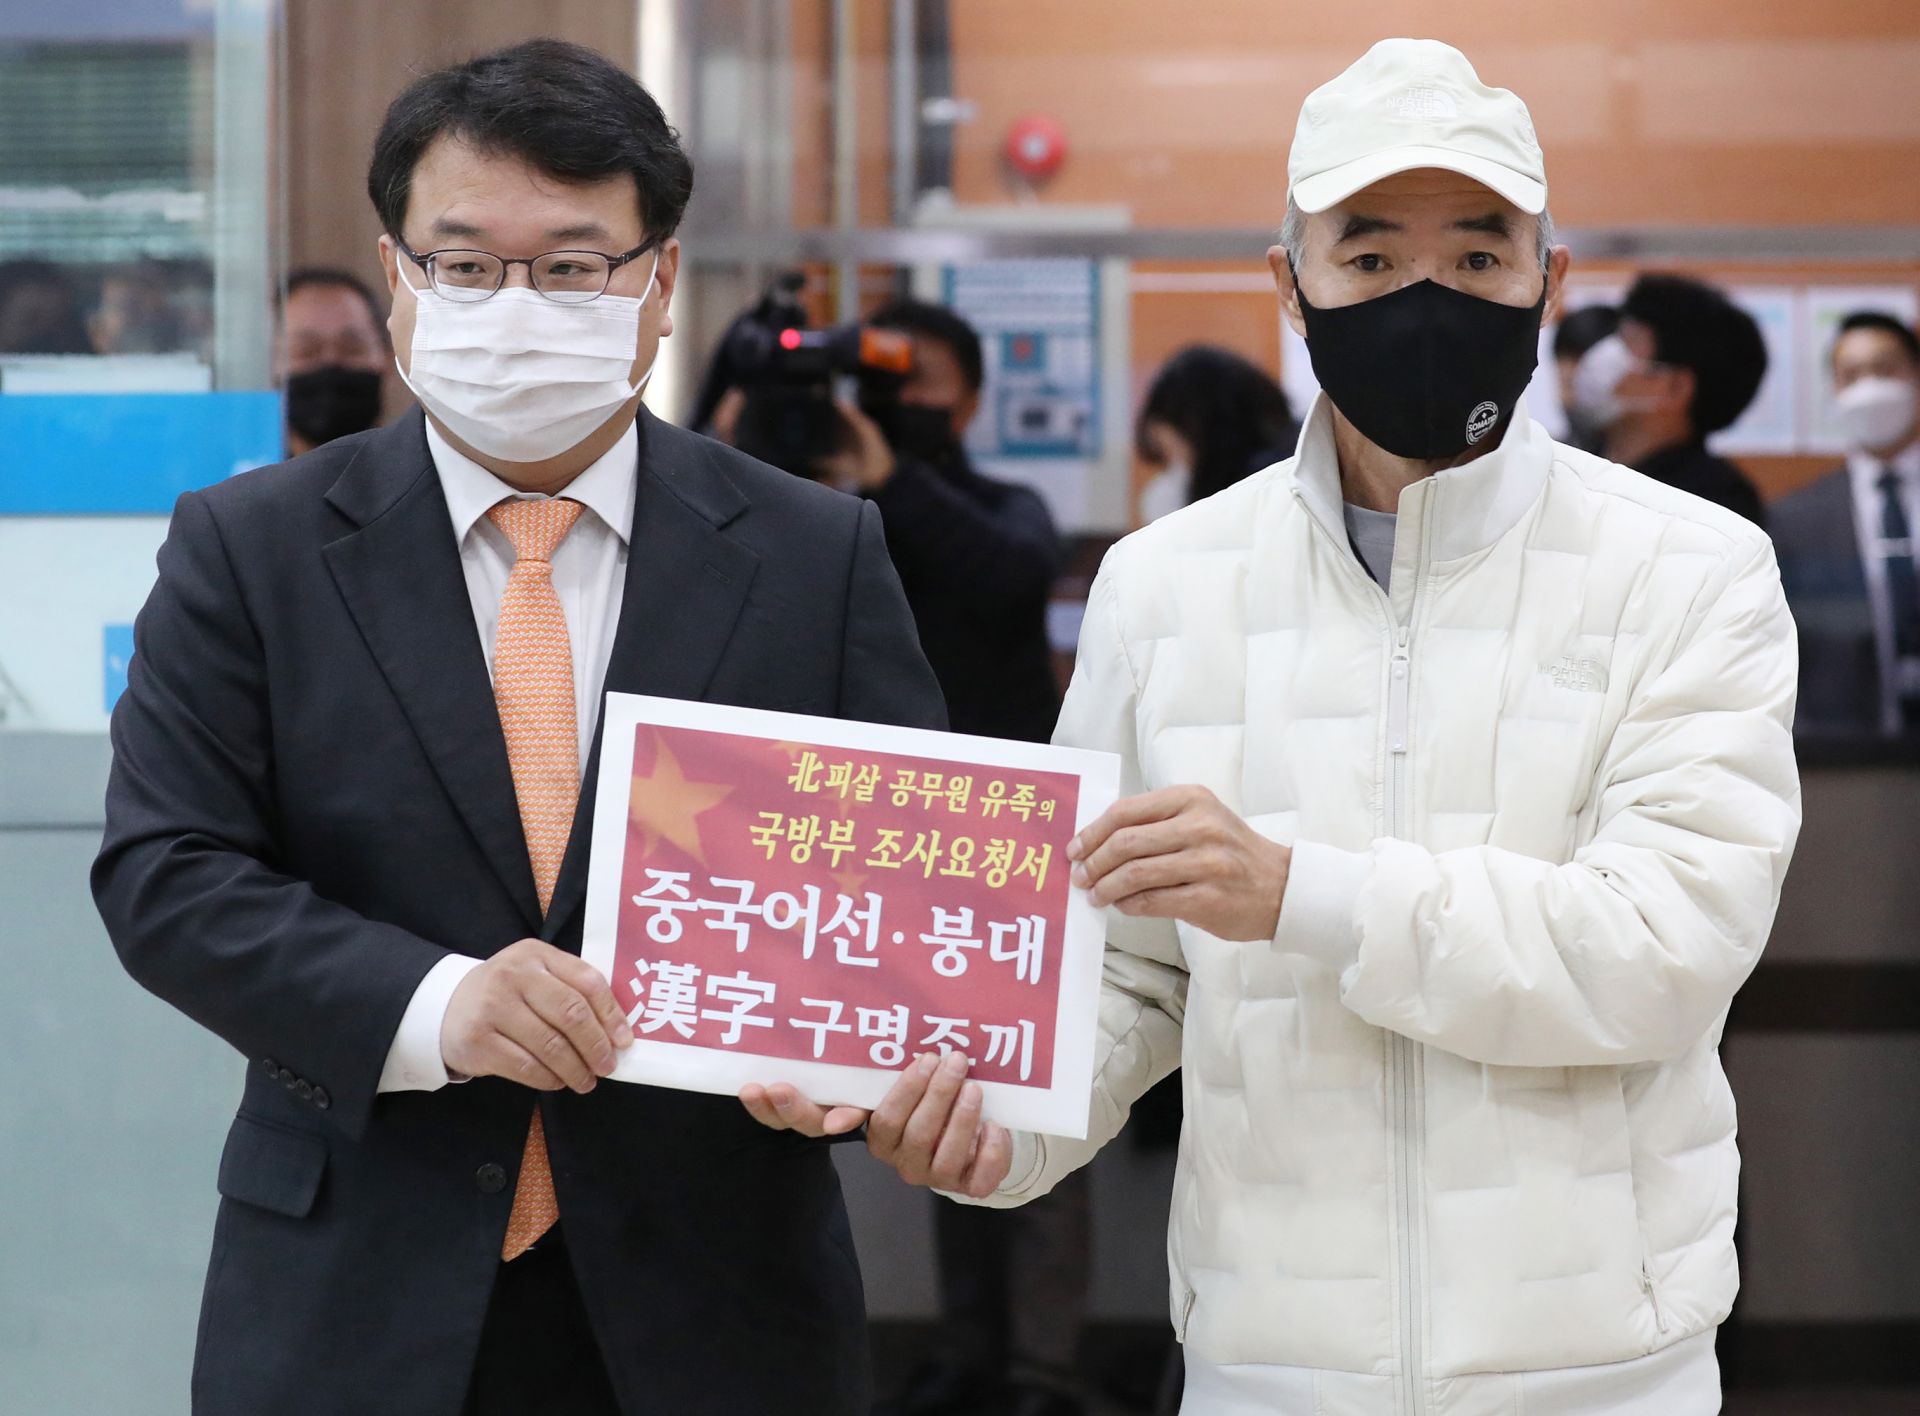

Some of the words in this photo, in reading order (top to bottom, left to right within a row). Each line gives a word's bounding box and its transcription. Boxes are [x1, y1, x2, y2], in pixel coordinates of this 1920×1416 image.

[788, 751, 881, 802] 北피살
[888, 769, 973, 813] 공무원
[979, 780, 1056, 822] 유족의
[749, 811, 856, 868] 국방부
[865, 828, 1053, 892] 조사요청서
[918, 905, 1047, 985] 붕대
[626, 958, 776, 1045] 漢字
[788, 997, 1036, 1081] 구명조끼
